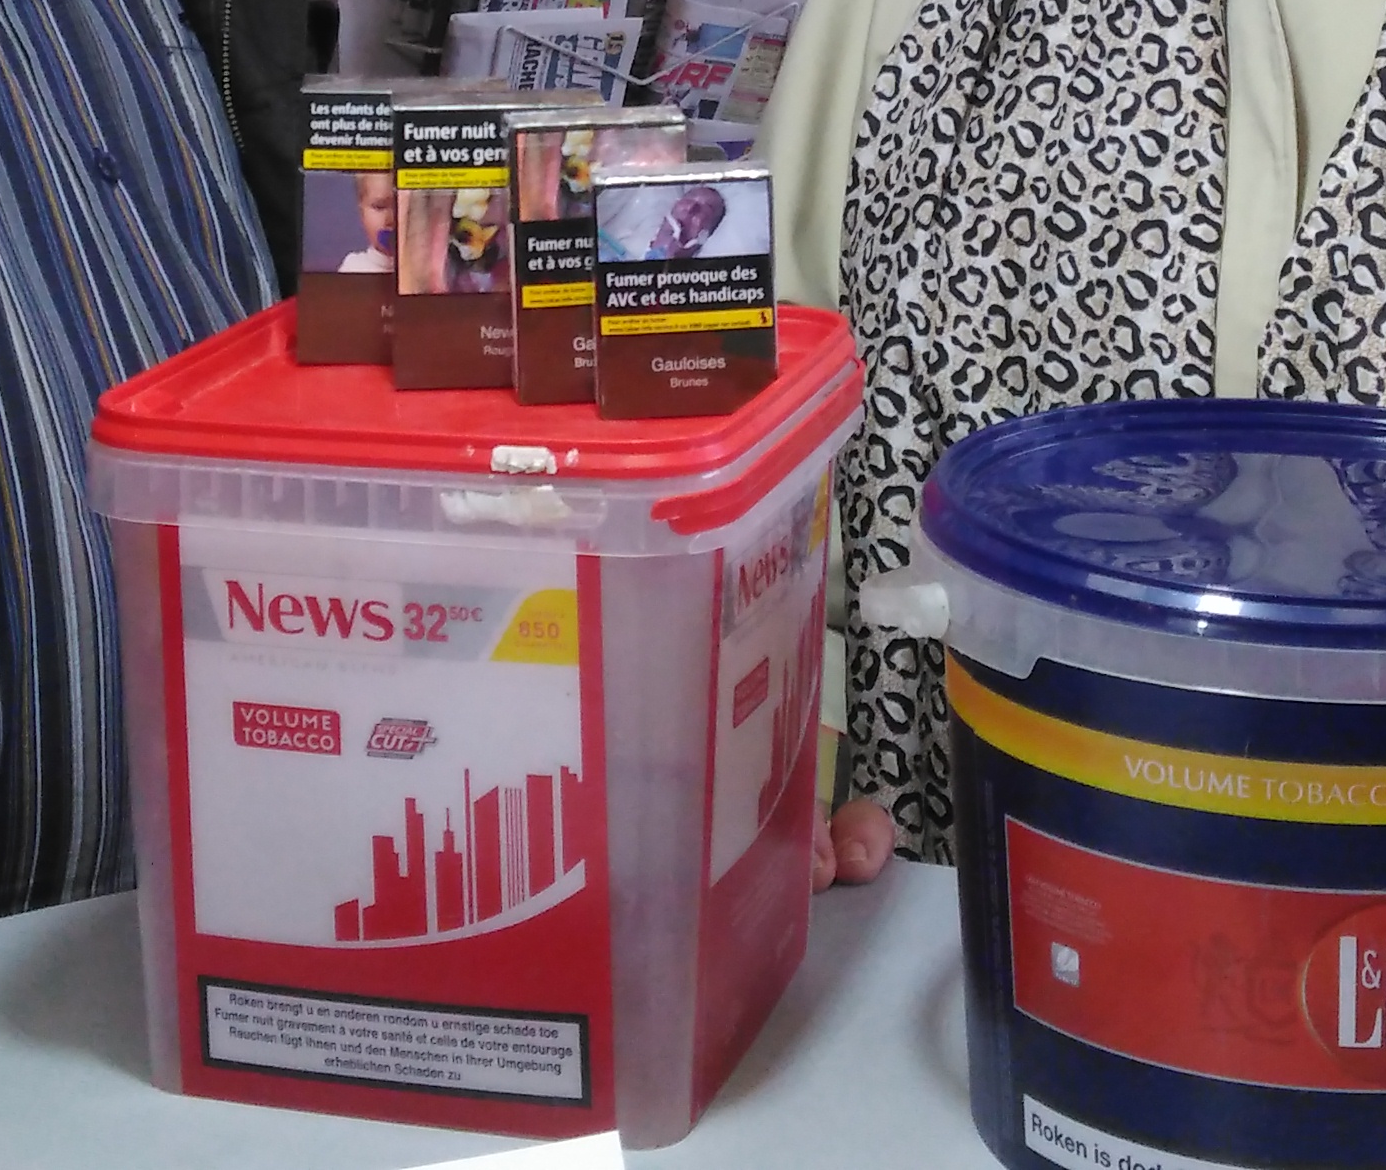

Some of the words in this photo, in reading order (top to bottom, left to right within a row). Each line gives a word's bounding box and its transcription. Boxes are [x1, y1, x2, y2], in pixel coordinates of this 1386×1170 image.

[310, 102, 329, 116] Les
[331, 102, 374, 116] enfants
[310, 119, 330, 131] ont
[331, 118, 356, 133] plus
[358, 118, 373, 131] de
[403, 122, 458, 141] Fumer
[462, 121, 497, 140] nuit
[310, 133, 353, 147] devenir
[403, 147, 423, 163] et
[426, 144, 439, 163] à
[440, 148, 470, 163] vos
[528, 236, 572, 252] Fumer
[528, 257, 543, 271] et
[546, 254, 555, 270] à
[558, 256, 582, 270] vos
[606, 272, 654, 289] Fumer
[657, 268, 728, 290] provoque
[730, 265, 758, 282] des
[606, 291, 638, 309] AVC
[640, 291, 657, 307] et
[659, 289, 687, 307] des
[689, 285, 766, 305] handicaps
[651, 353, 726, 374] Gauloises
[669, 375, 709, 389] Brunes
[225, 579, 395, 643] News
[239, 706, 333, 732] VOLUME
[241, 727, 336, 752] TOBACCO
[370, 734, 408, 751] CUT
[1123, 754, 1251, 800] VOLUME
[229, 993, 264, 1009] Roken
[266, 998, 303, 1017] brengt
[316, 1007, 331, 1017] en
[334, 1008, 381, 1024] anderen
[383, 1013, 429, 1029] rondom
[431, 1020, 439, 1029] u
[441, 1019, 490, 1036] ernstige
[493, 1023, 537, 1039] schade
[539, 1026, 560, 1040] toe
[215, 1007, 250, 1024] Fumer
[252, 1014, 274, 1027] nuit
[277, 1018, 336, 1035] gravement
[349, 1026, 379, 1039] votre
[382, 1028, 413, 1043] santé
[415, 1031, 427, 1045] et
[430, 1035, 458, 1048] celle
[460, 1036, 476, 1049] de
[477, 1040, 509, 1053] votre
[512, 1043, 574, 1060] entourage
[229, 1026, 278, 1044] Rauchen
[340, 1039, 363, 1054] und
[365, 1042, 387, 1057] den
[389, 1046, 449, 1064] Menschen
[451, 1052, 463, 1065] in
[496, 1056, 562, 1076] Umgebung
[323, 1055, 391, 1074] erheblichen
[394, 1063, 445, 1079] Schaden
[447, 1070, 462, 1081] zu
[1030, 1111, 1088, 1160] Roken
[1092, 1143, 1112, 1169] is
